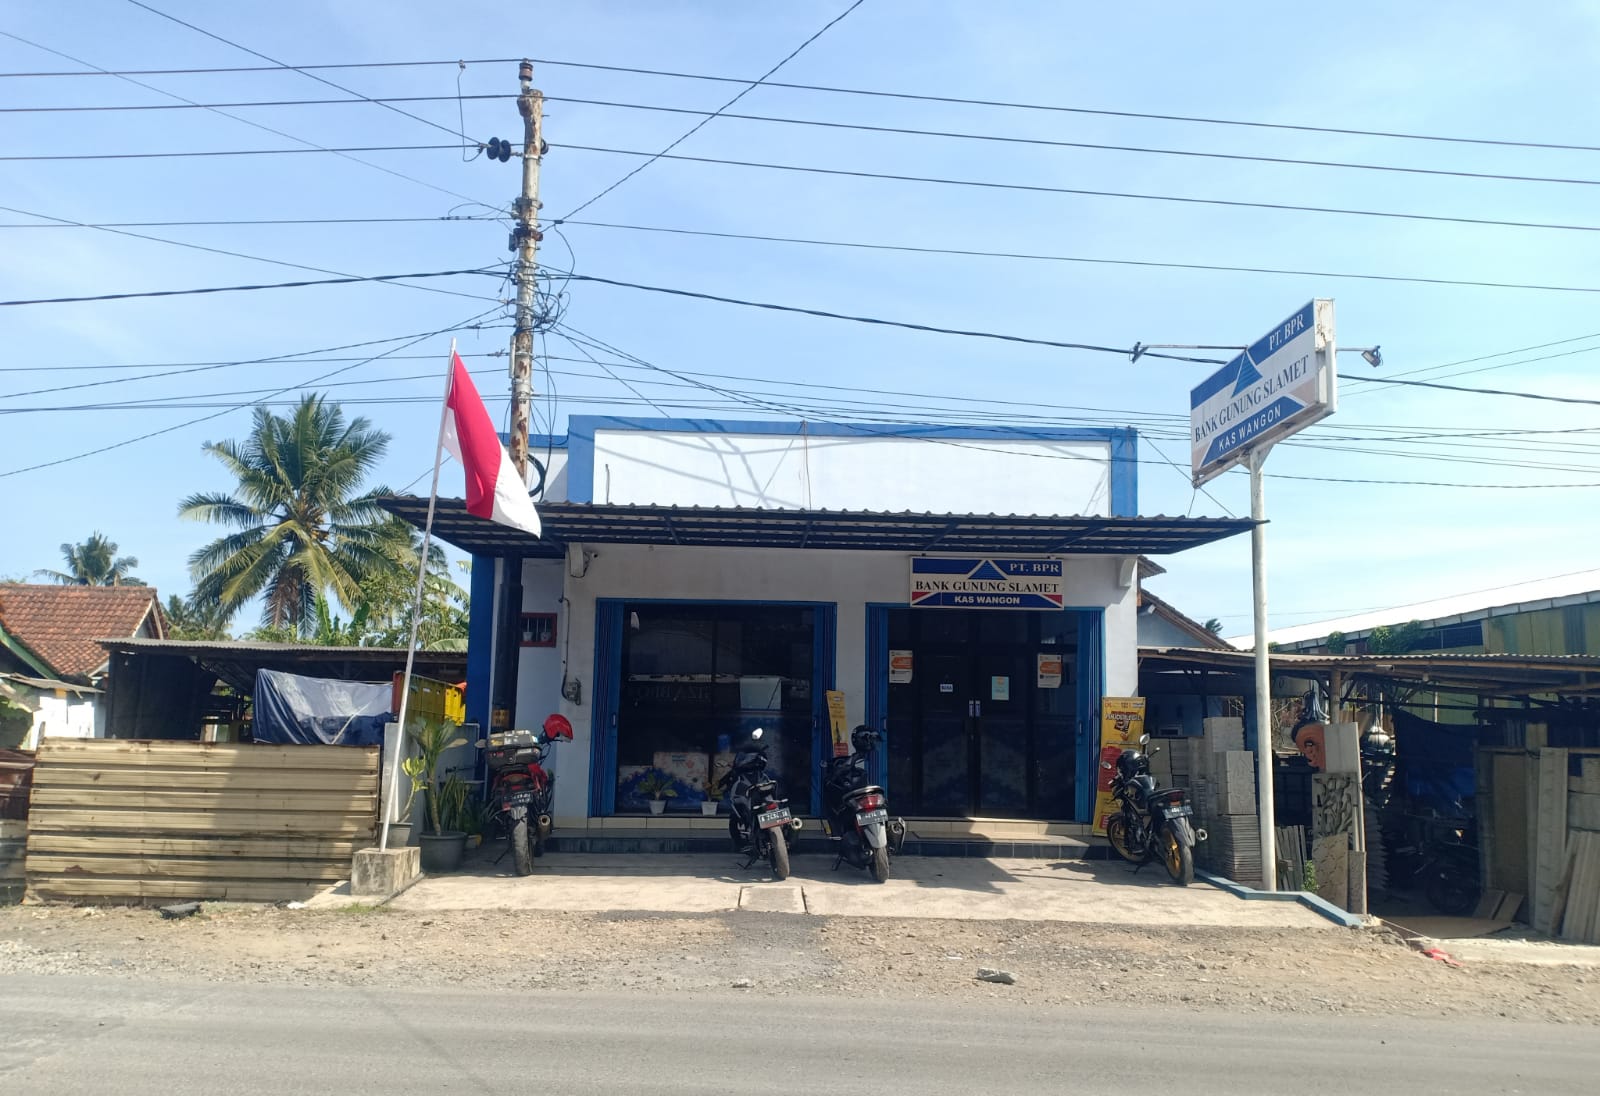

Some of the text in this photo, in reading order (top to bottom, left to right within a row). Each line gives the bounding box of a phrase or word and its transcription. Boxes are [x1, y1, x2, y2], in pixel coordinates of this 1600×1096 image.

[1269, 313, 1304, 351] PT. BPR
[1195, 354, 1309, 443] BANK GUNUNG SLAMET
[1218, 404, 1281, 452] KAS WANGON
[1009, 563, 1060, 573] PT. BPR
[915, 580, 1060, 593] BANK GUNUNG SLAMET
[954, 595, 1020, 605] KAS WANGON
